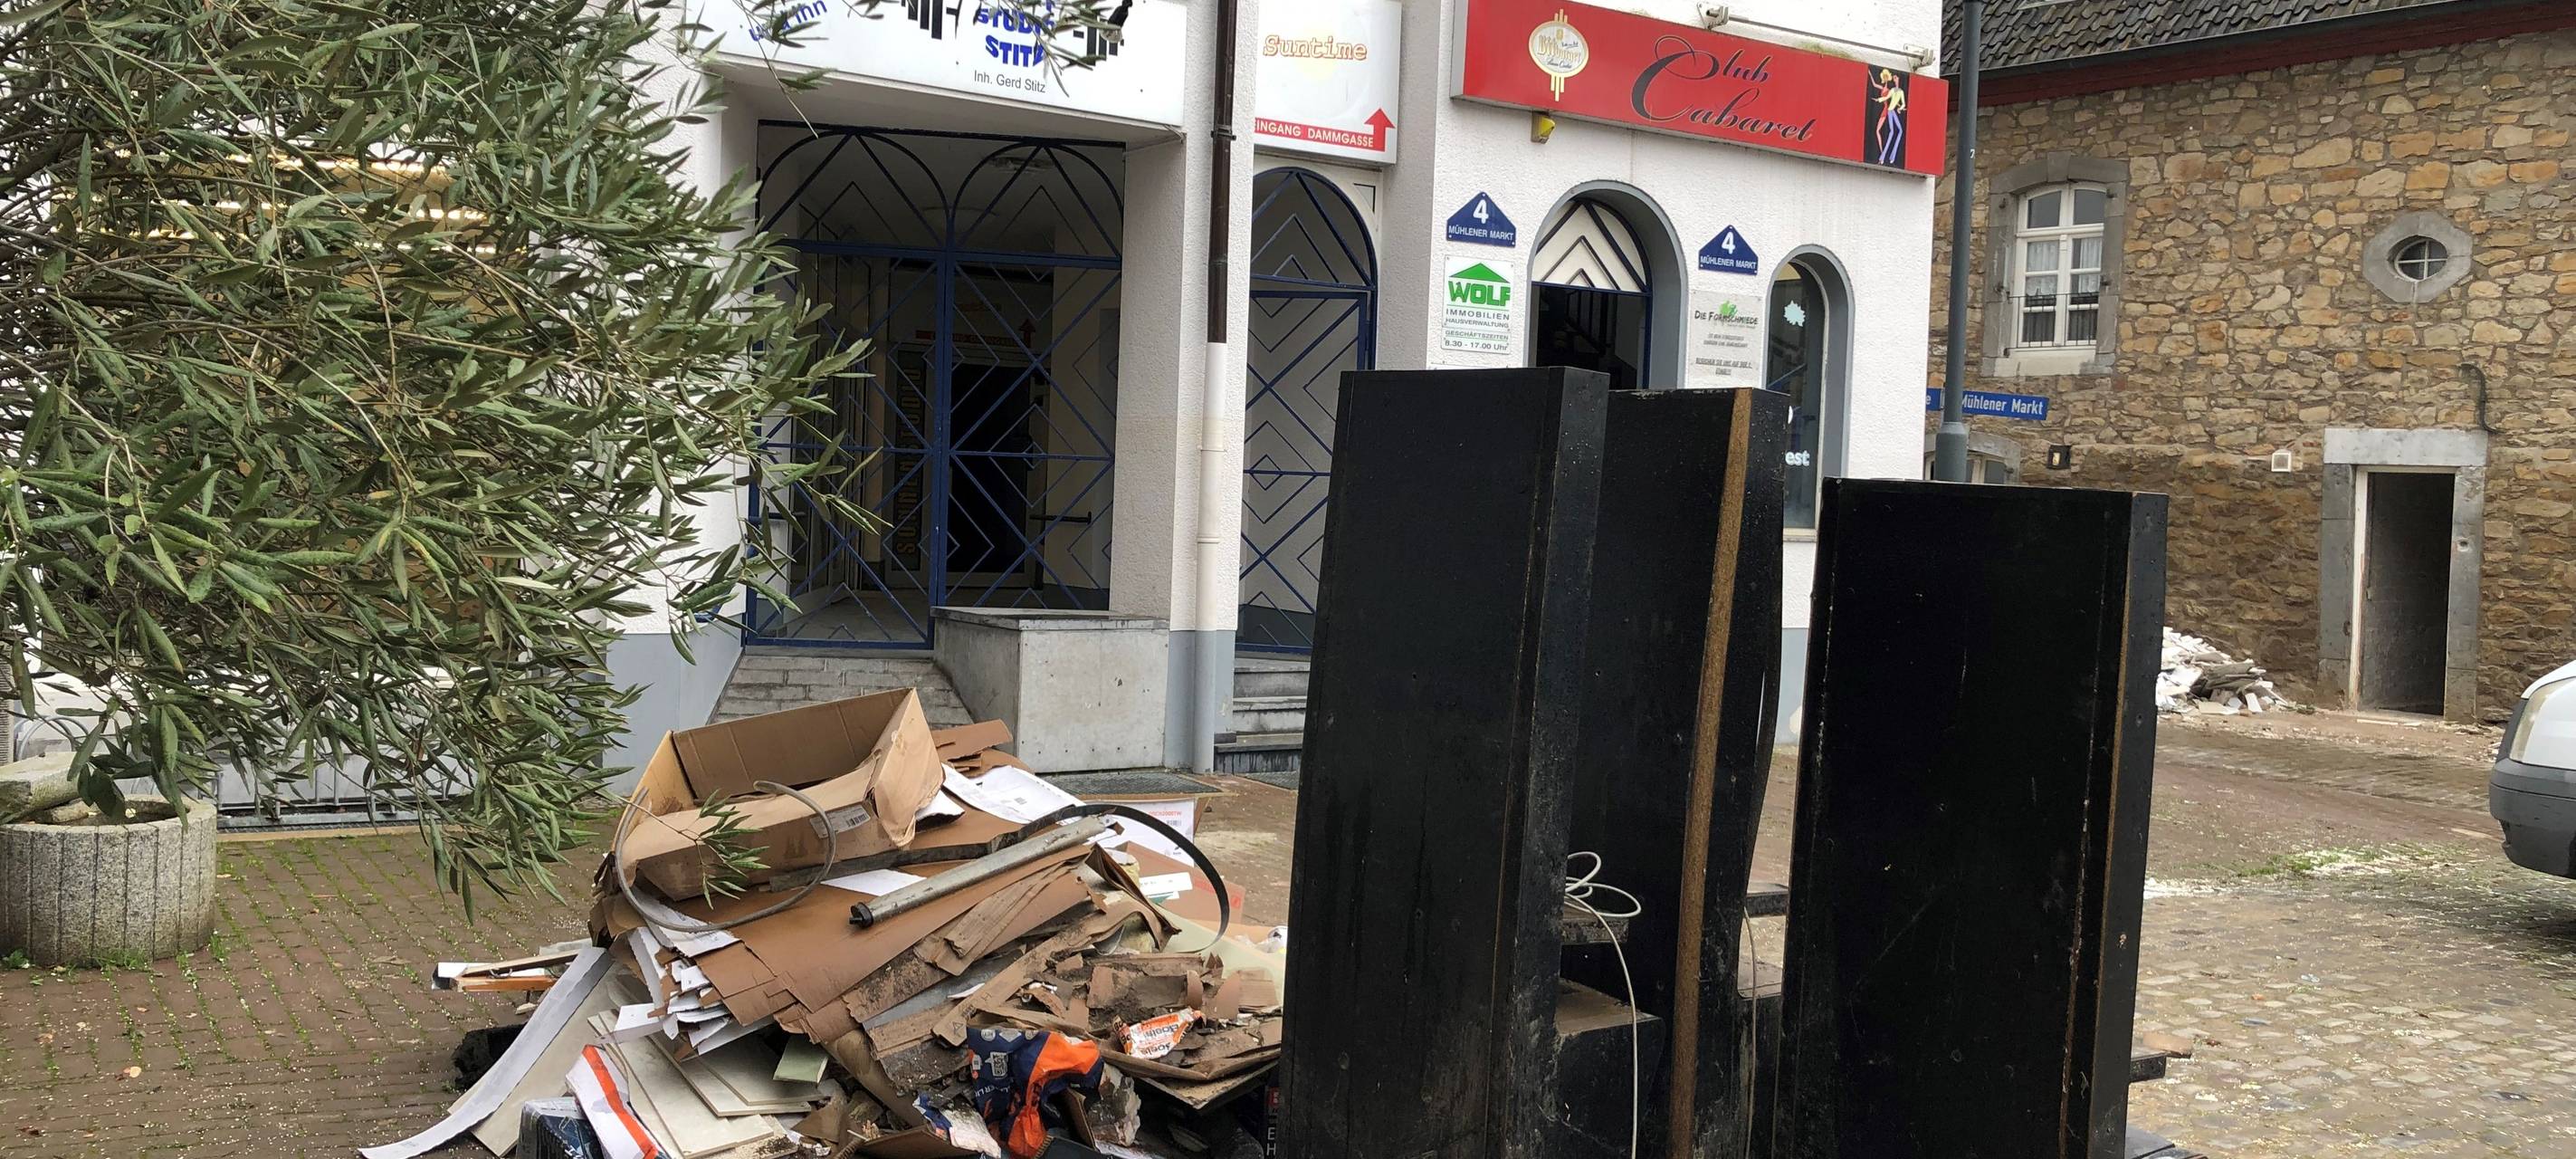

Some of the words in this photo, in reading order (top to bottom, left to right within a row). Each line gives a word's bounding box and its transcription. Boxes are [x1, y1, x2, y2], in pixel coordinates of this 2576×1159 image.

[986, 34, 1045, 68] STITZ
[1263, 34, 1368, 61] Suntime
[974, 70, 993, 84] Inh.
[997, 73, 1022, 89] Gerd
[1025, 79, 1045, 93] Stitz
[1632, 68, 1817, 142] Cabaret
[1255, 120, 1302, 137] INGANG
[1307, 128, 1374, 148] DAMMGASSE
[1473, 199, 1489, 225] 4
[1448, 225, 1488, 237] MÜHLENER
[1490, 230, 1513, 241] MARKT
[1721, 231, 1736, 254] 4
[1700, 254, 1734, 267] MÜHLENER
[1735, 260, 1757, 270] MARKT
[1448, 280, 1511, 307] WOLF
[1445, 308, 1510, 321] IMMOBILIEN
[1471, 341, 1492, 350] 17.00
[1493, 343, 1508, 351] Uhr
[2011, 398, 2044, 416] Markt
